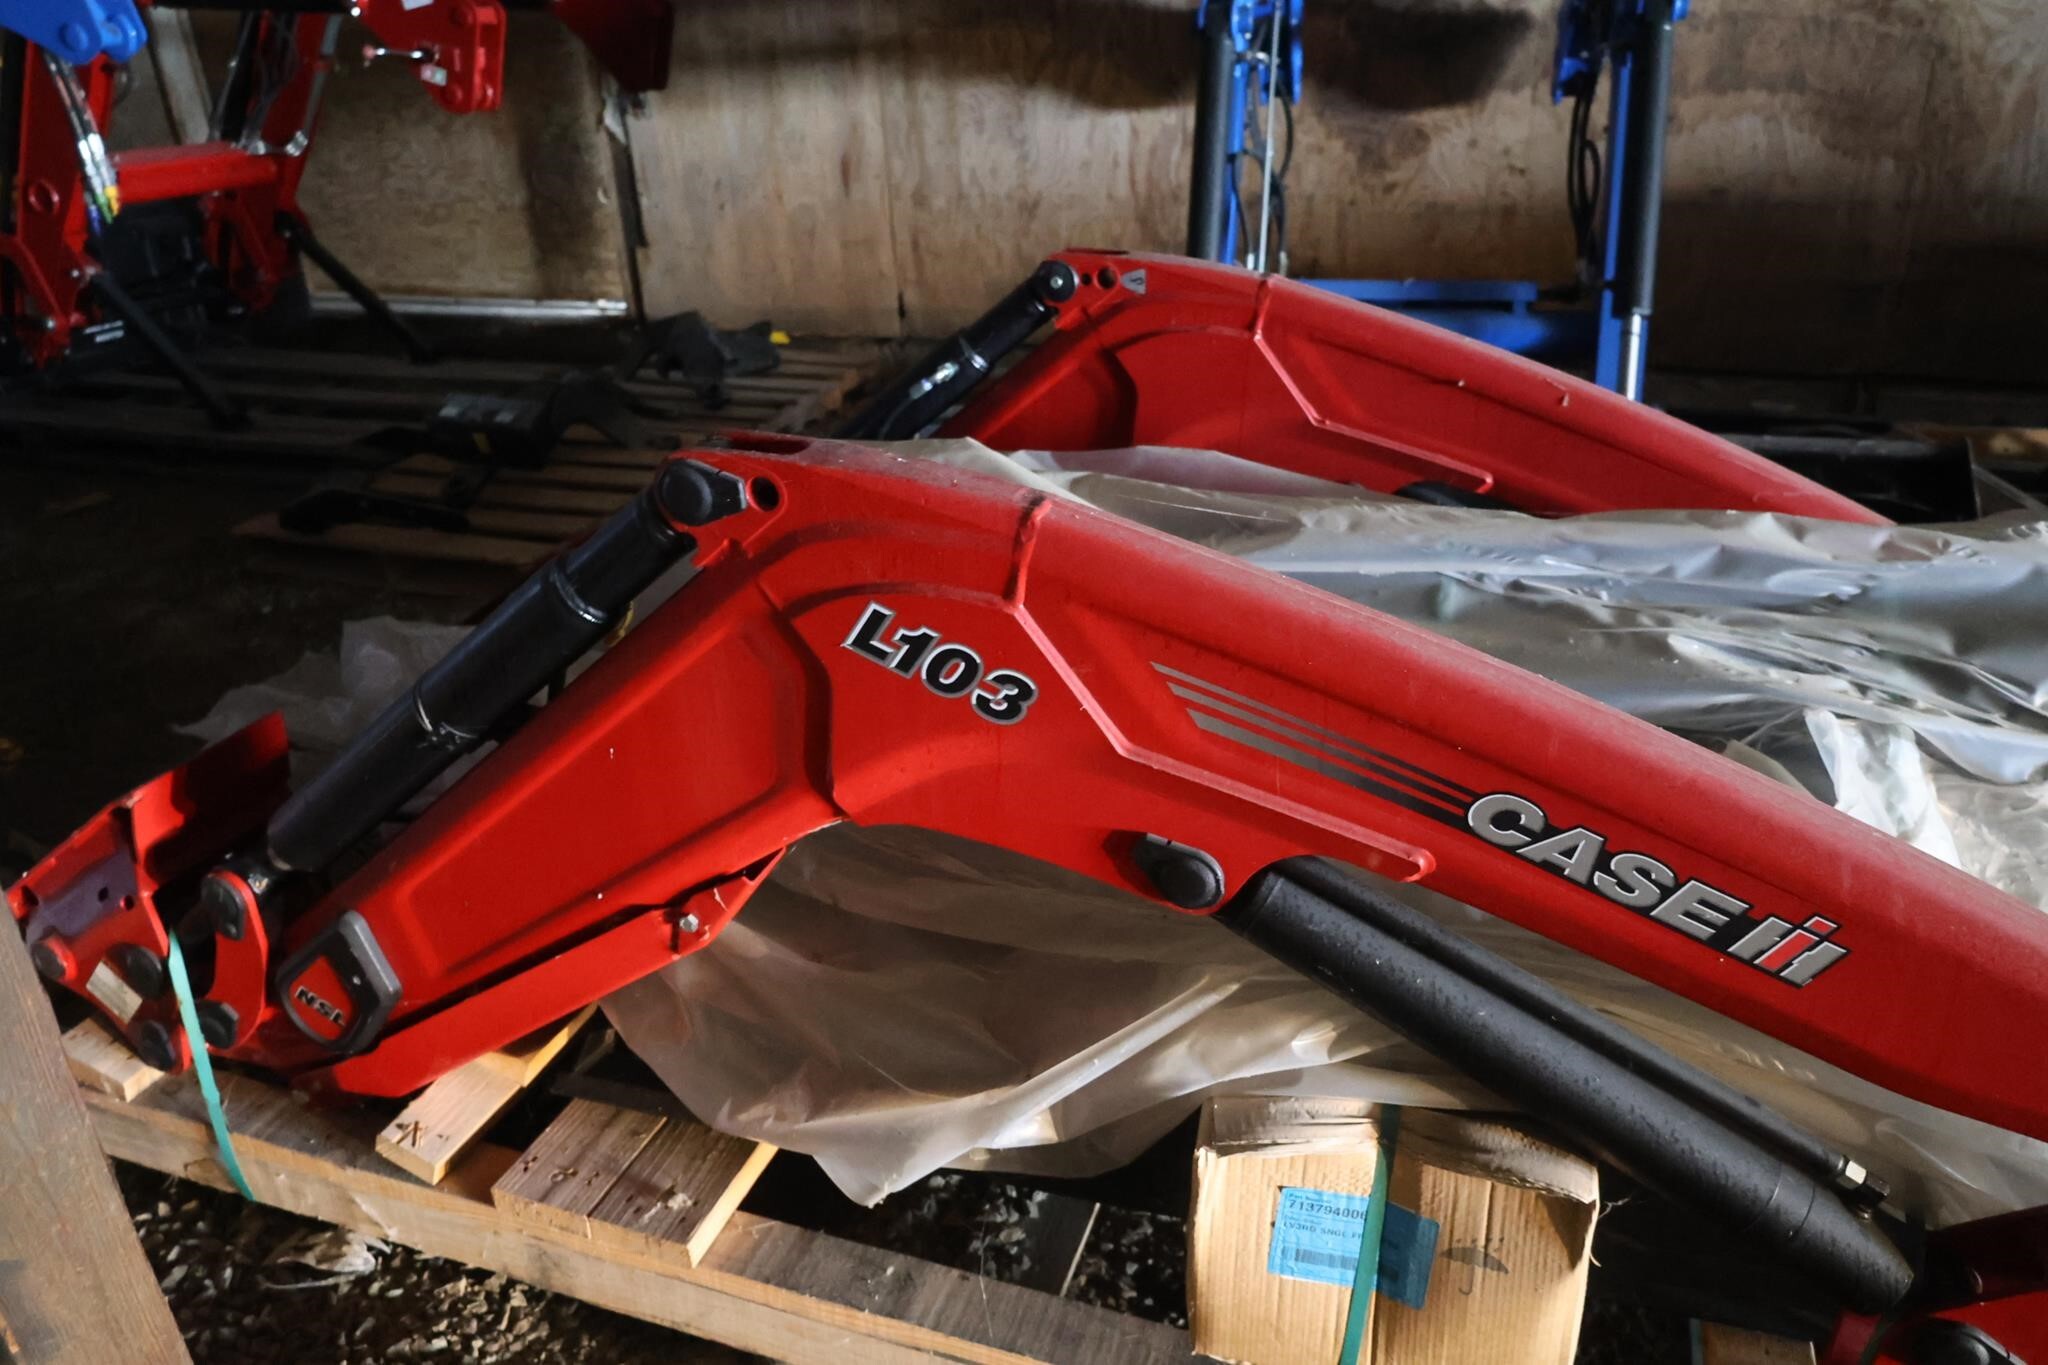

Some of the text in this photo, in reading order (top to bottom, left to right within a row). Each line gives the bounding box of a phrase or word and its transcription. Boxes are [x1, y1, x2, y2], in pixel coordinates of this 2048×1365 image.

[840, 601, 1038, 725] L103
[1466, 793, 1752, 942] CASE
[295, 985, 345, 1027] NSL
